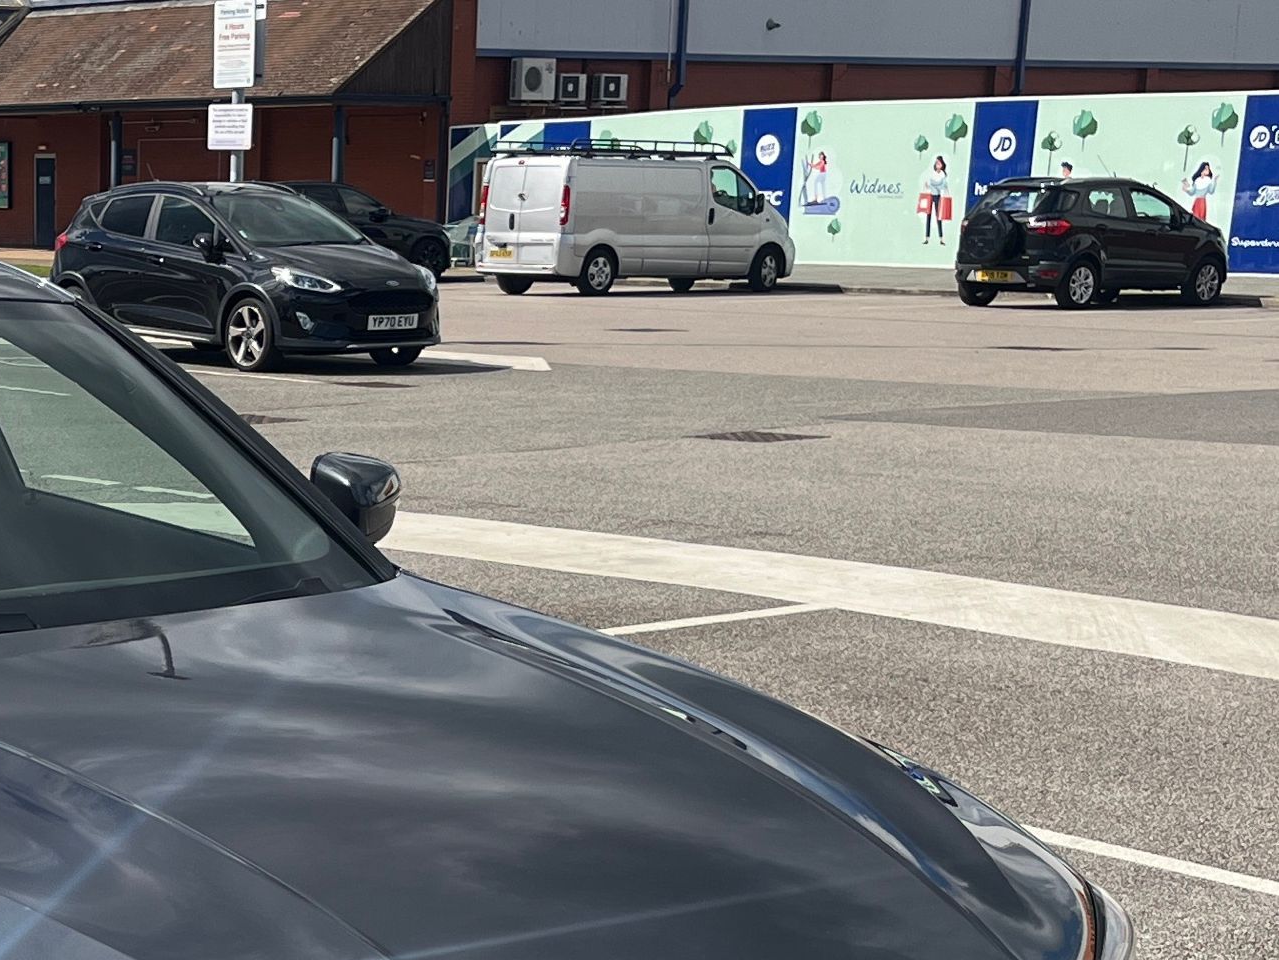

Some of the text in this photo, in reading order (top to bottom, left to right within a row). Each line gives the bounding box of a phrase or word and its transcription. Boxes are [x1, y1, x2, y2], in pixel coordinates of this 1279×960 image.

[1253, 131, 1267, 143] JD
[993, 136, 1012, 152] JD
[372, 315, 415, 328] YP70 EYU
